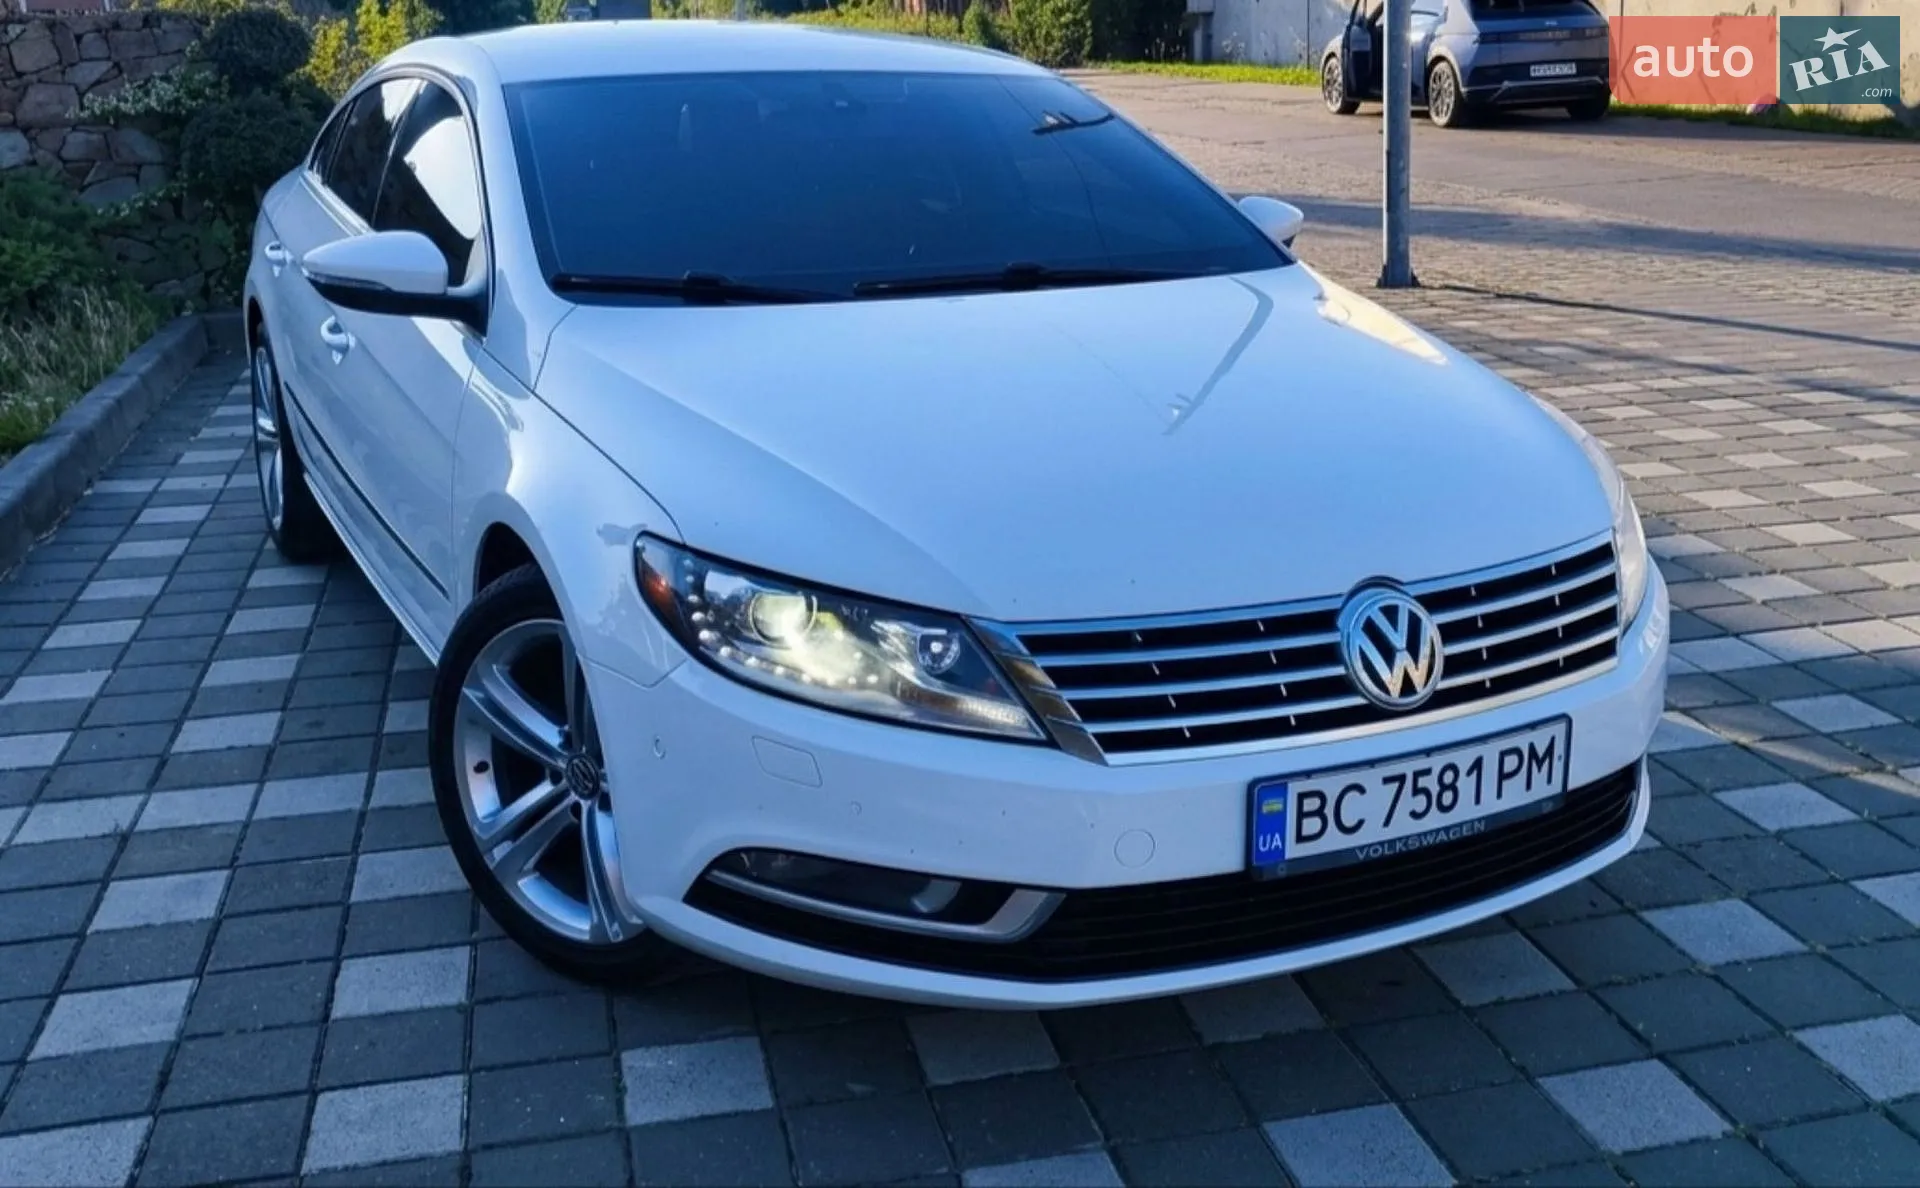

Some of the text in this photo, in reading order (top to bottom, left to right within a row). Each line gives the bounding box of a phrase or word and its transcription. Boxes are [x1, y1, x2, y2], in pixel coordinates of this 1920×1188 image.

[1350, 598, 1435, 702] VW
[1295, 735, 1556, 845] BC 7581 PM
[1258, 832, 1283, 852] UA
[1354, 819, 1487, 861] VOLKSWAGEN
